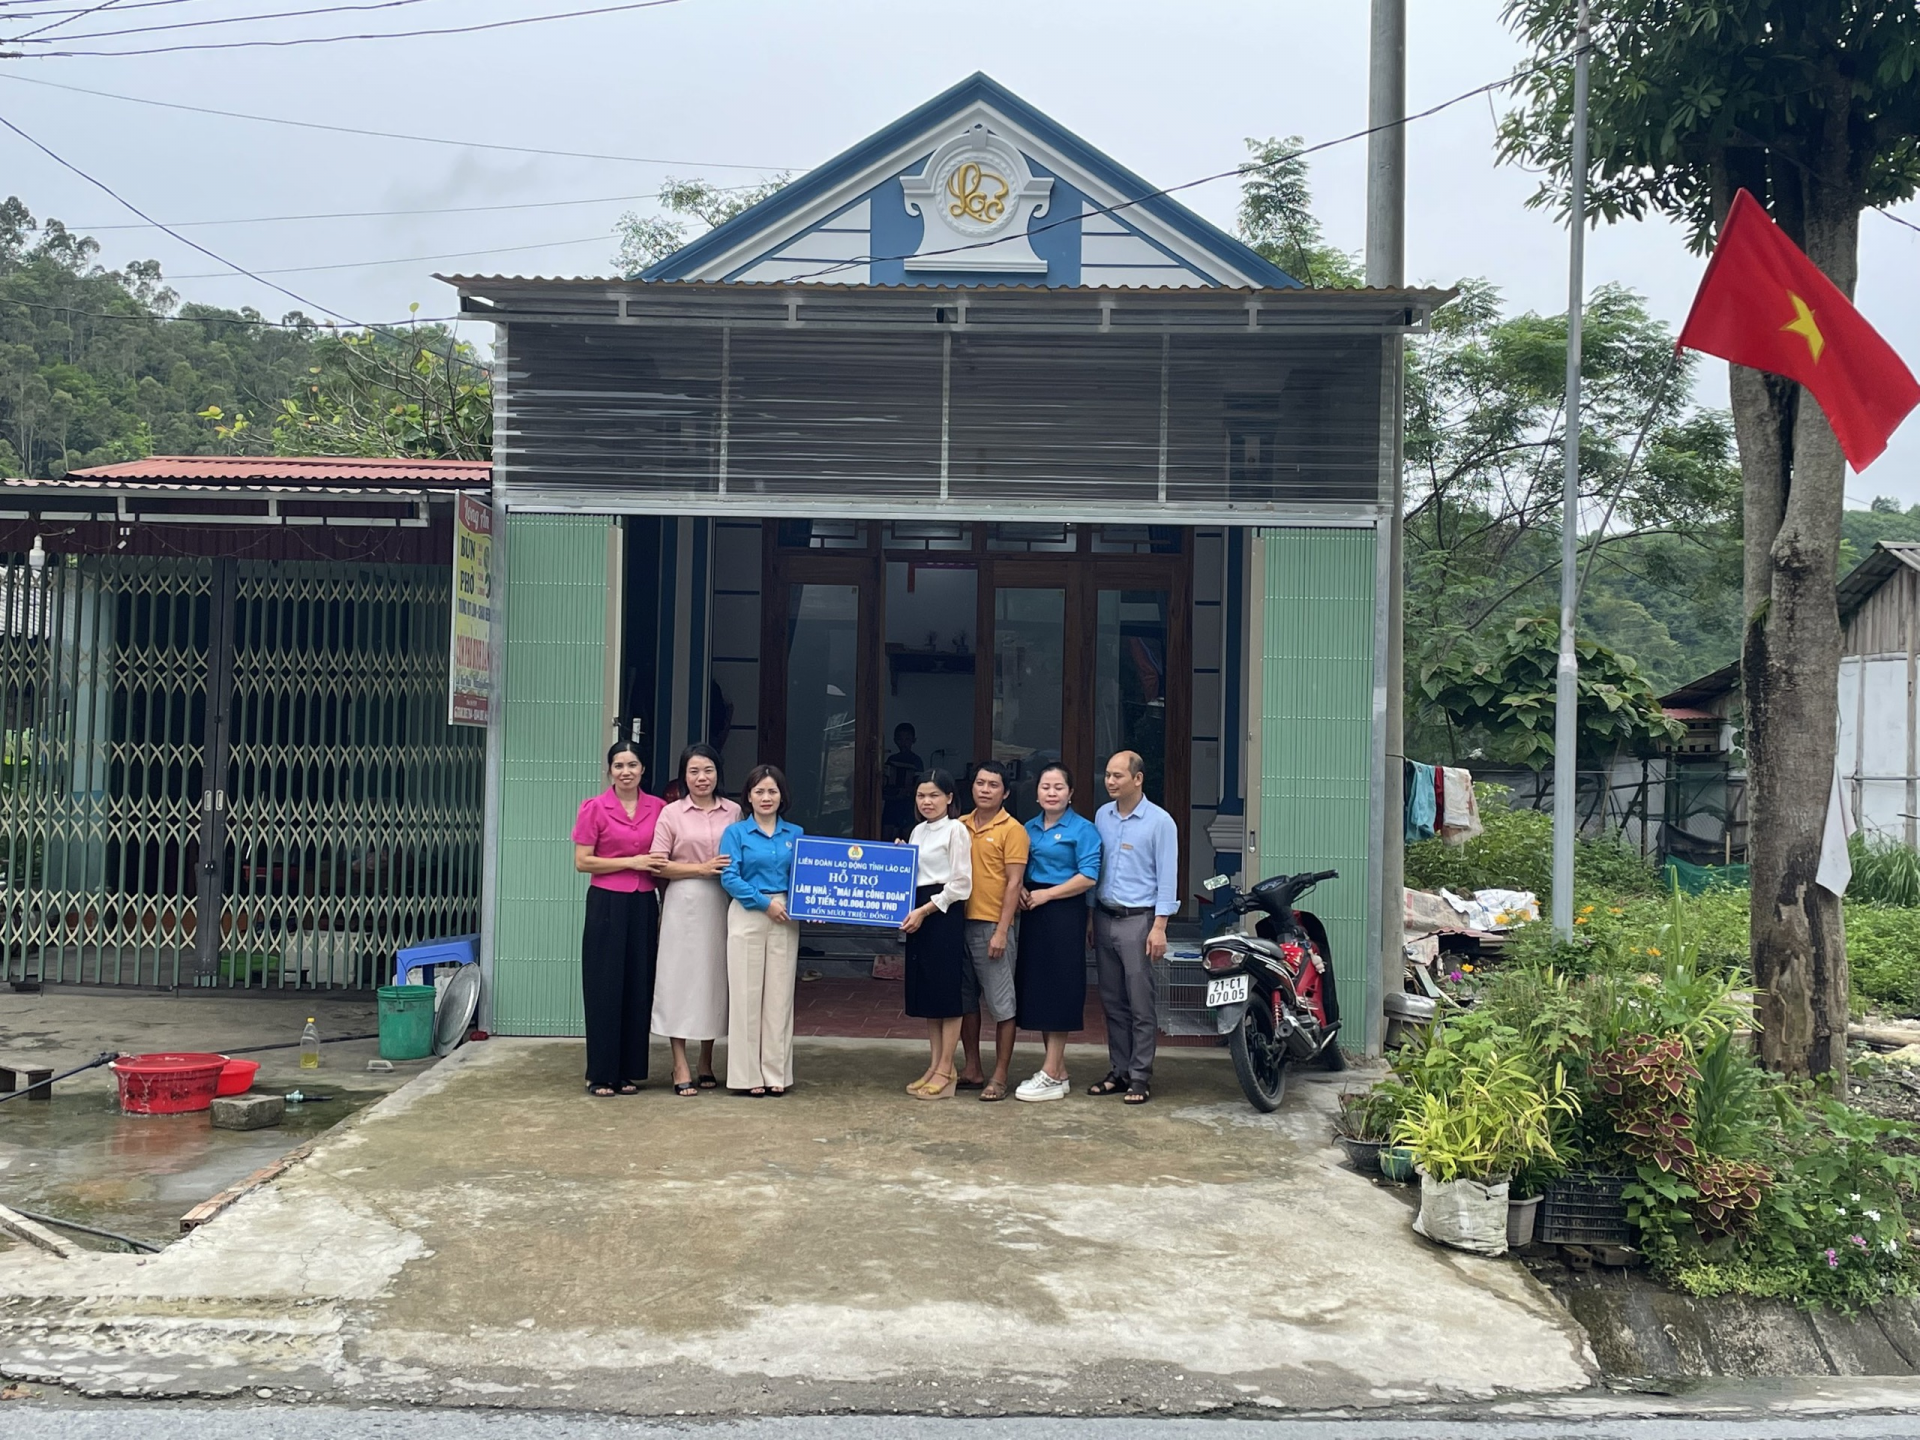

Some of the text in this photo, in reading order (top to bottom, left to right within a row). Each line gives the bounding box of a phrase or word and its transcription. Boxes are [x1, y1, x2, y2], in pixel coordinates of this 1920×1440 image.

[461, 532, 475, 561] BÚN
[814, 858, 832, 867] ĐOÀN
[849, 861, 867, 870] ĐỘNG
[885, 864, 898, 872] LÀO
[900, 866, 911, 874] CAI
[828, 869, 879, 888] HỖ TRỢ
[795, 884, 811, 894] LÀM
[812, 885, 827, 895] NHÀ
[865, 889, 884, 900] CÔNG
[805, 894, 817, 905] SỐ
[838, 899, 879, 910] 40.000.000
[1214, 978, 1240, 992] 21-C1
[1209, 989, 1244, 1004] 070.05
